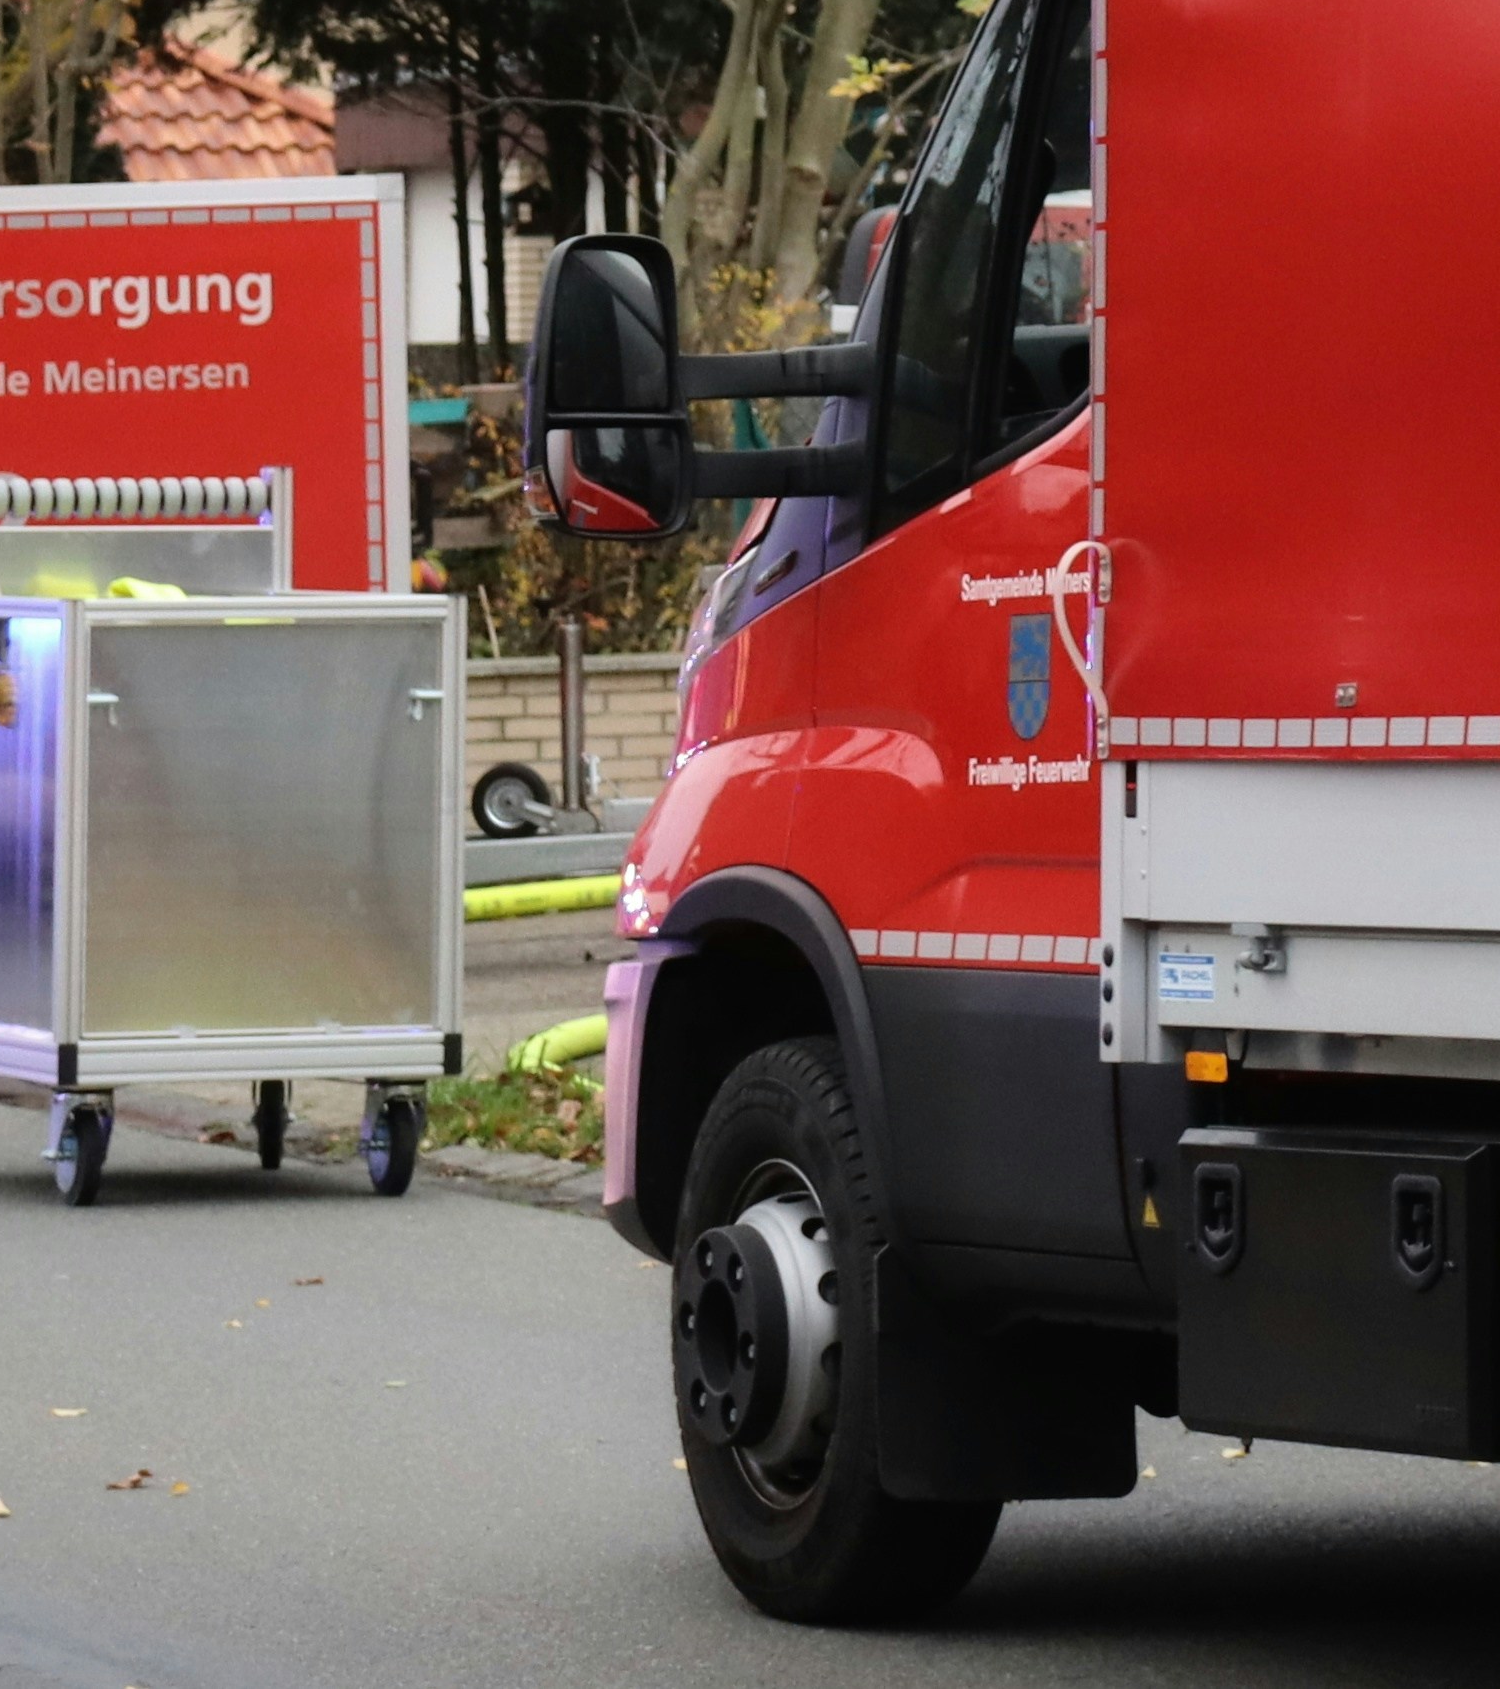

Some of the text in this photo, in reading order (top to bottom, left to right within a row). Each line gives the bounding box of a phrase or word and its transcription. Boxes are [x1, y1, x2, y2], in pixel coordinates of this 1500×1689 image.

[42, 358, 250, 395] Meinersen
[960, 568, 1045, 607] Samtgemeinde
[967, 753, 1091, 792] Freiwillige Feuerwehr
